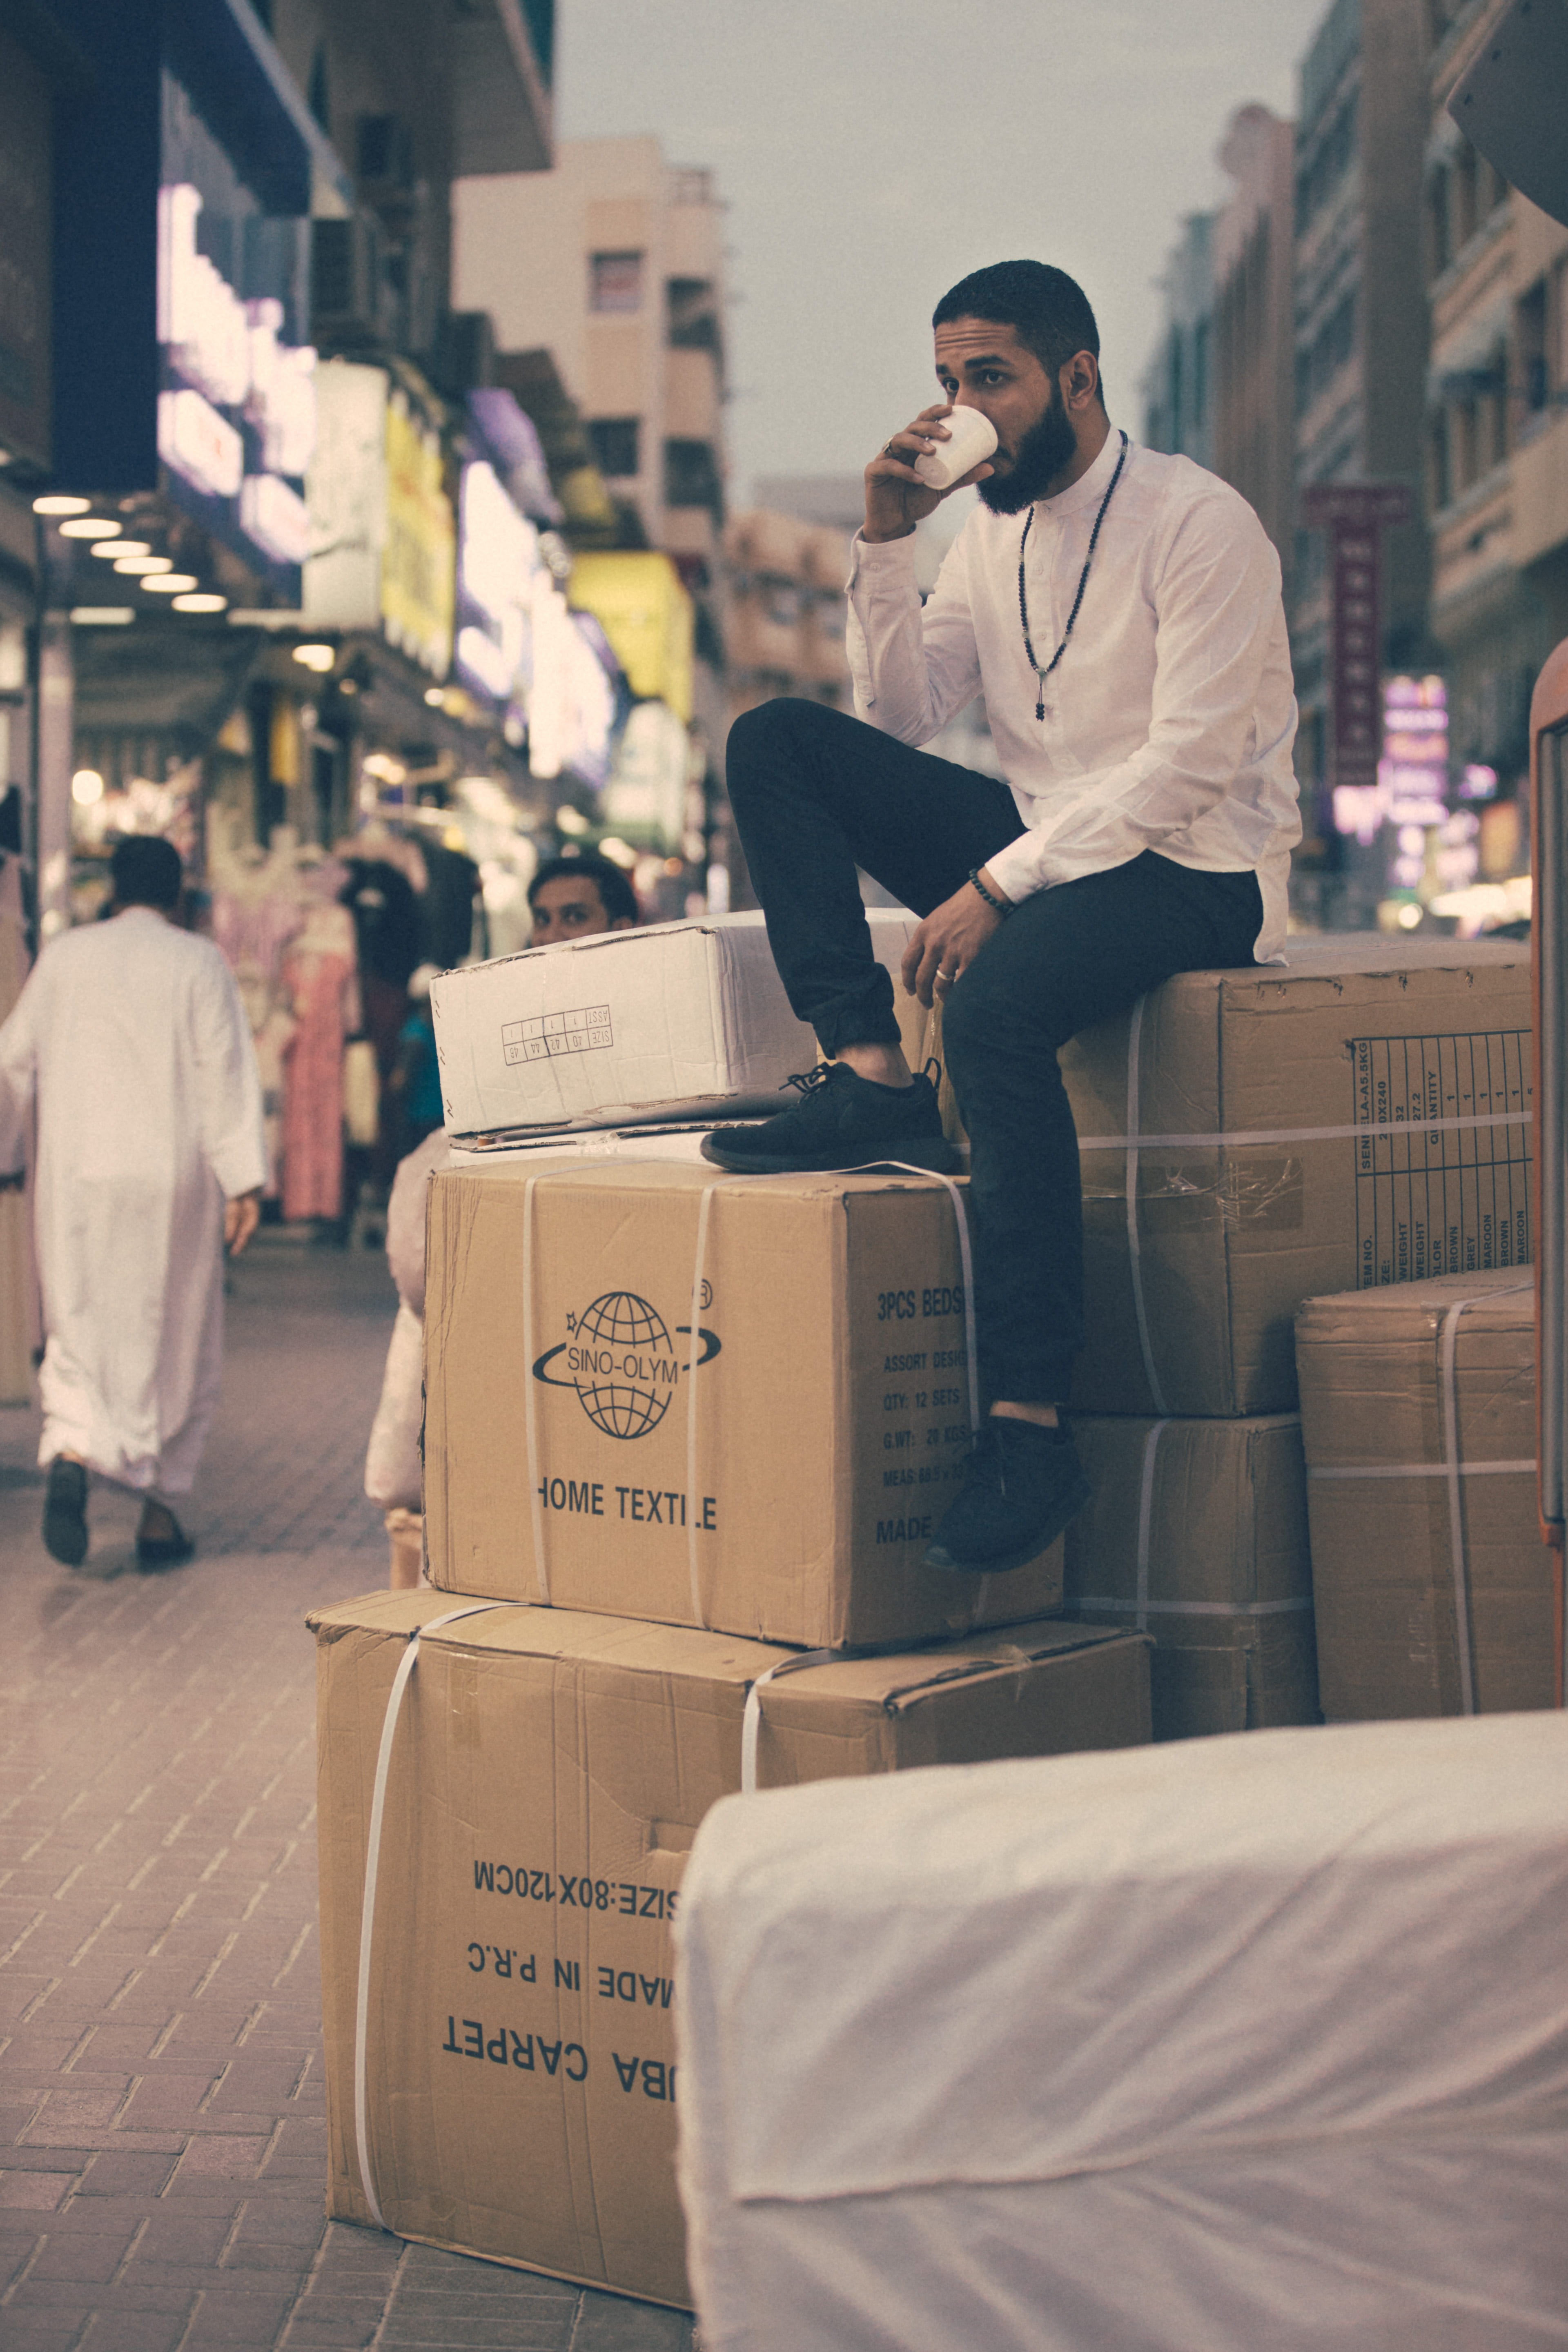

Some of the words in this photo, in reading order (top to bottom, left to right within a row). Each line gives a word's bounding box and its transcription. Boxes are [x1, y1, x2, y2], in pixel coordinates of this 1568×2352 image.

[589, 1010, 607, 1023] ASST
[510, 1047, 518, 1058] 46
[531, 1043, 540, 1054] 44
[551, 1039, 560, 1050] 42
[573, 1036, 582, 1047] 40
[593, 1030, 610, 1044] SIZE
[1359, 1042, 1370, 1169] SENELA-A5.5KG
[1378, 1081, 1387, 1140] 20X240
[1363, 1235, 1372, 1261] NO.
[1416, 1222, 1424, 1278] WEIGHT
[1450, 1226, 1458, 1273] BROWN
[1467, 1237, 1475, 1270] GREY
[1483, 1214, 1491, 1268] MAROON
[1433, 1240, 1441, 1277] OLOR
[1363, 1265, 1372, 1290] EM
[878, 1290, 915, 1321] 3PCS
[922, 1286, 965, 1316] BEDS
[568, 1348, 678, 1384] SINO-OLYM
[884, 1353, 927, 1372] ASSORT
[933, 1350, 967, 1369] DESIG
[915, 1391, 927, 1408] 12
[932, 1388, 960, 1406] SETS
[538, 1477, 604, 1515] HOME
[615, 1486, 717, 1530] TEXTIE
[876, 1516, 932, 1544] MADE
[468, 1942, 536, 1983] P.R.C
[554, 1959, 580, 1991] IN
[443, 2016, 588, 2082] CARPET
